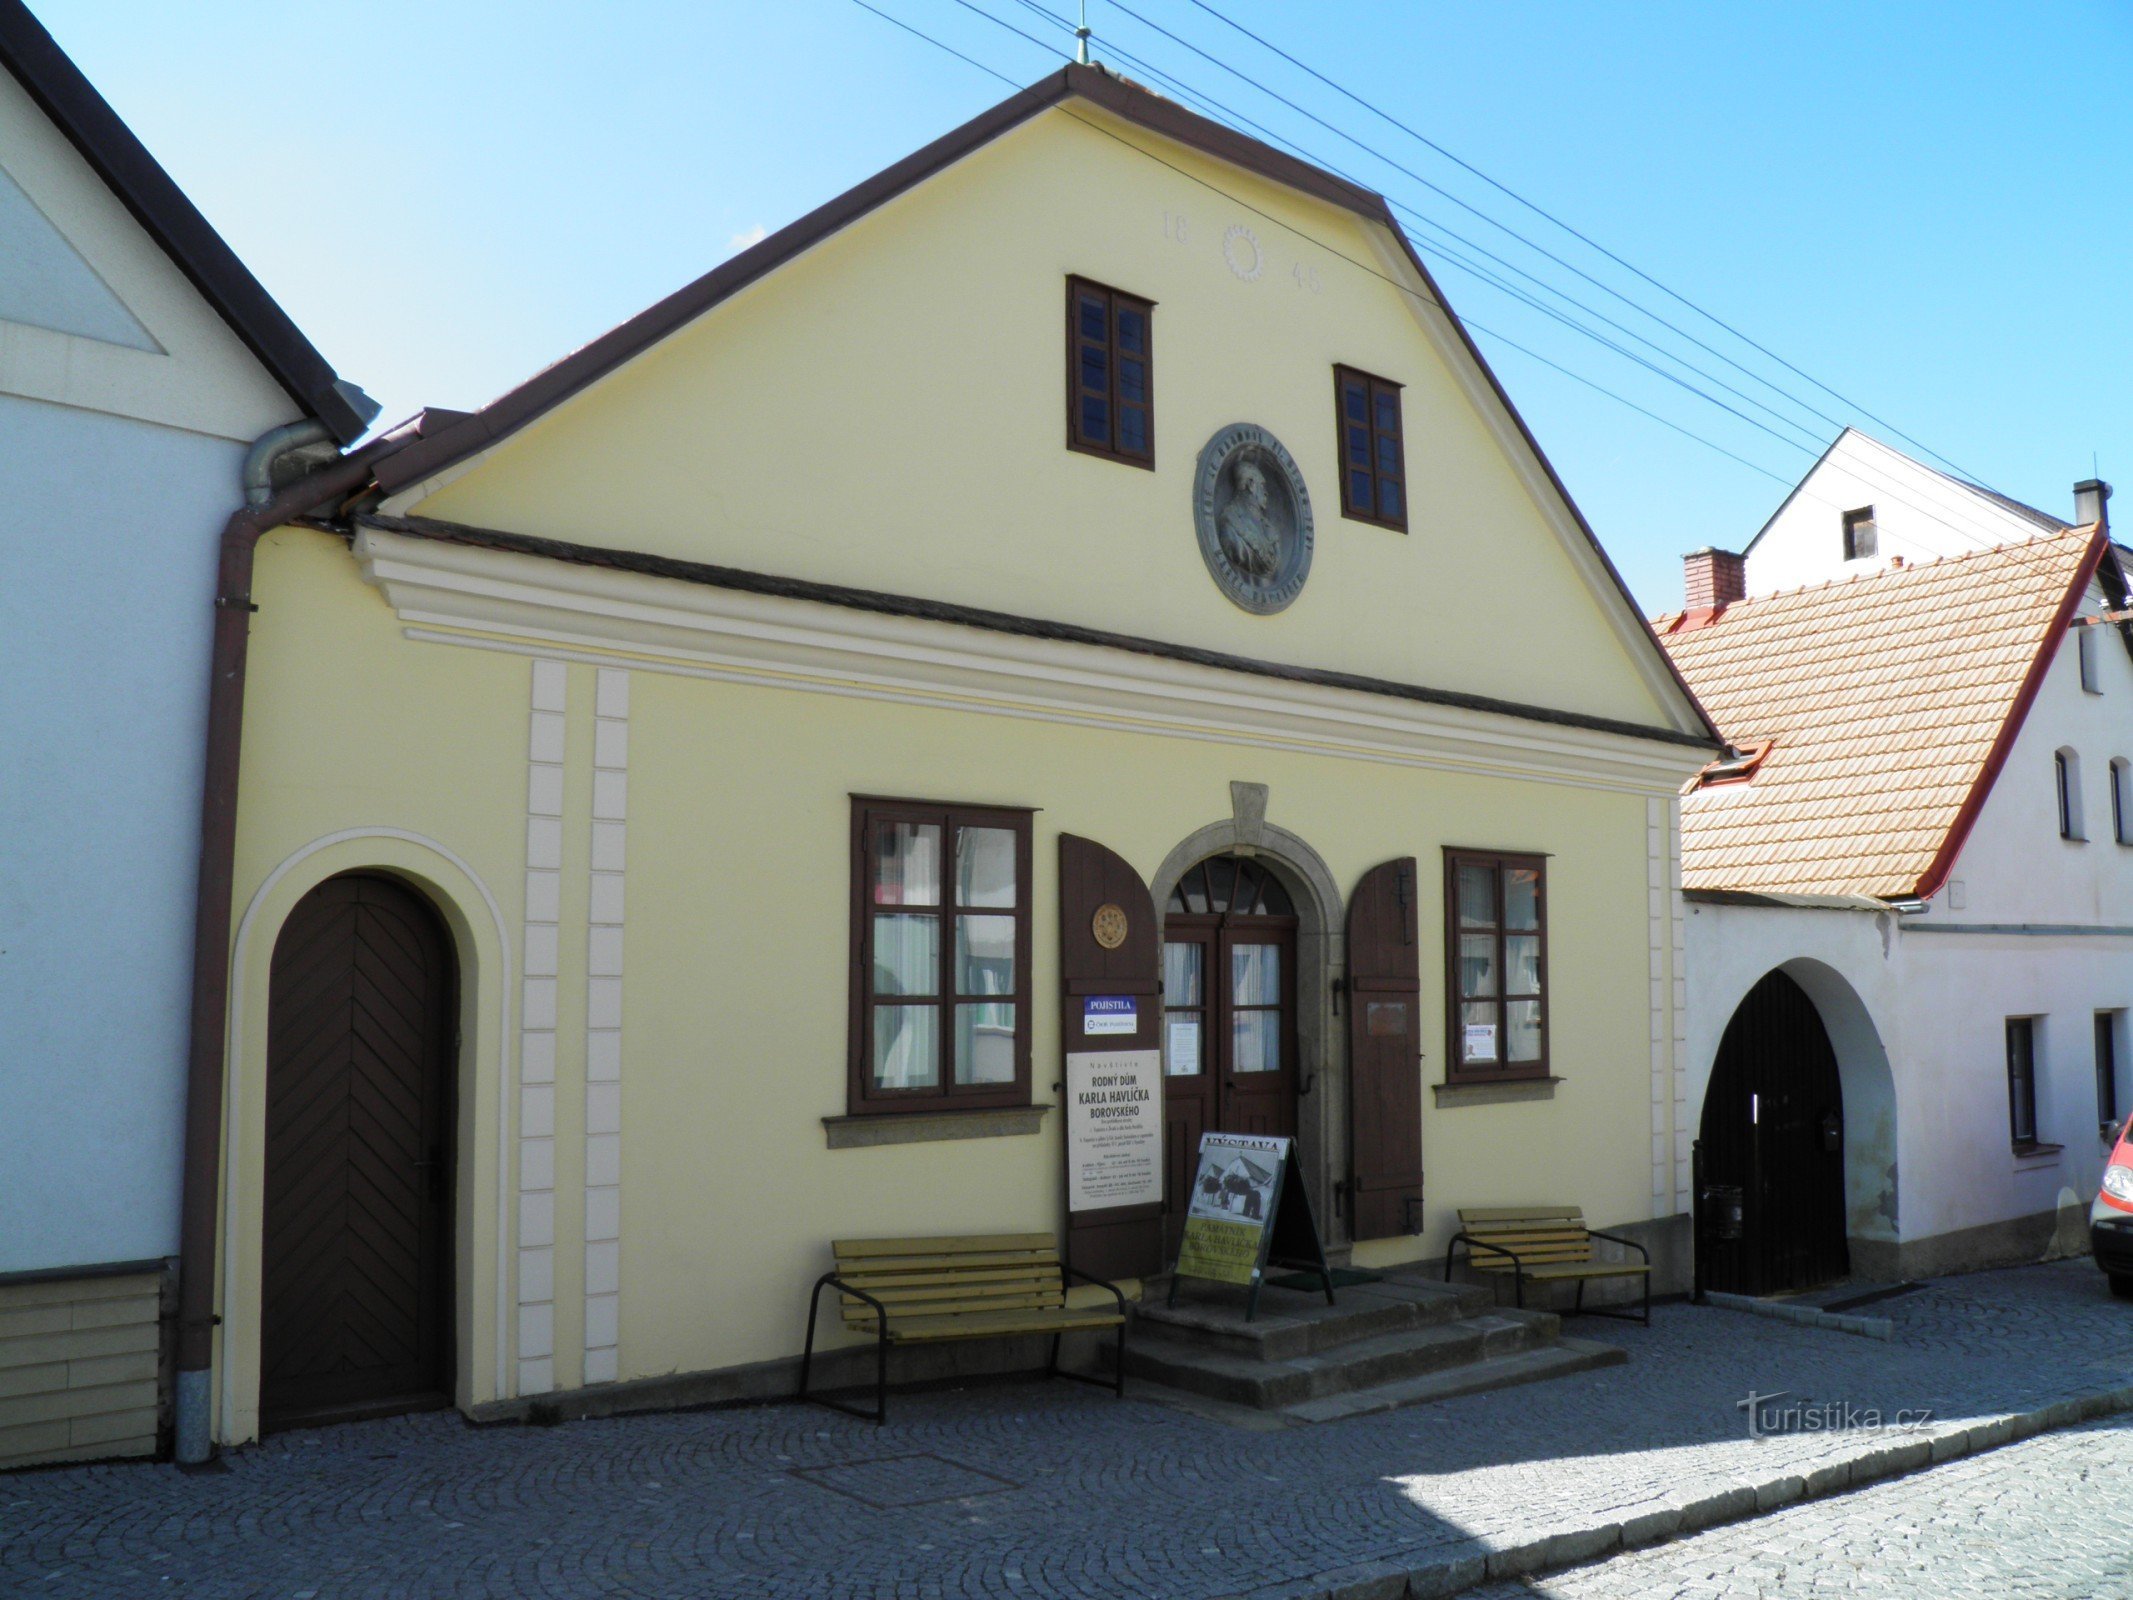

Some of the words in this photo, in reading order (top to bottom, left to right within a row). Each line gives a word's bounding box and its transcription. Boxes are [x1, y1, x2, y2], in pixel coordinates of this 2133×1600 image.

[1092, 1073, 1118, 1087] RODNÝ
[1120, 1072, 1137, 1086] DŮM
[1079, 1091, 1107, 1105] KARLA
[1109, 1087, 1150, 1104] HAVLÍČKA
[1090, 1103, 1140, 1119] BOROVSKÉHO
